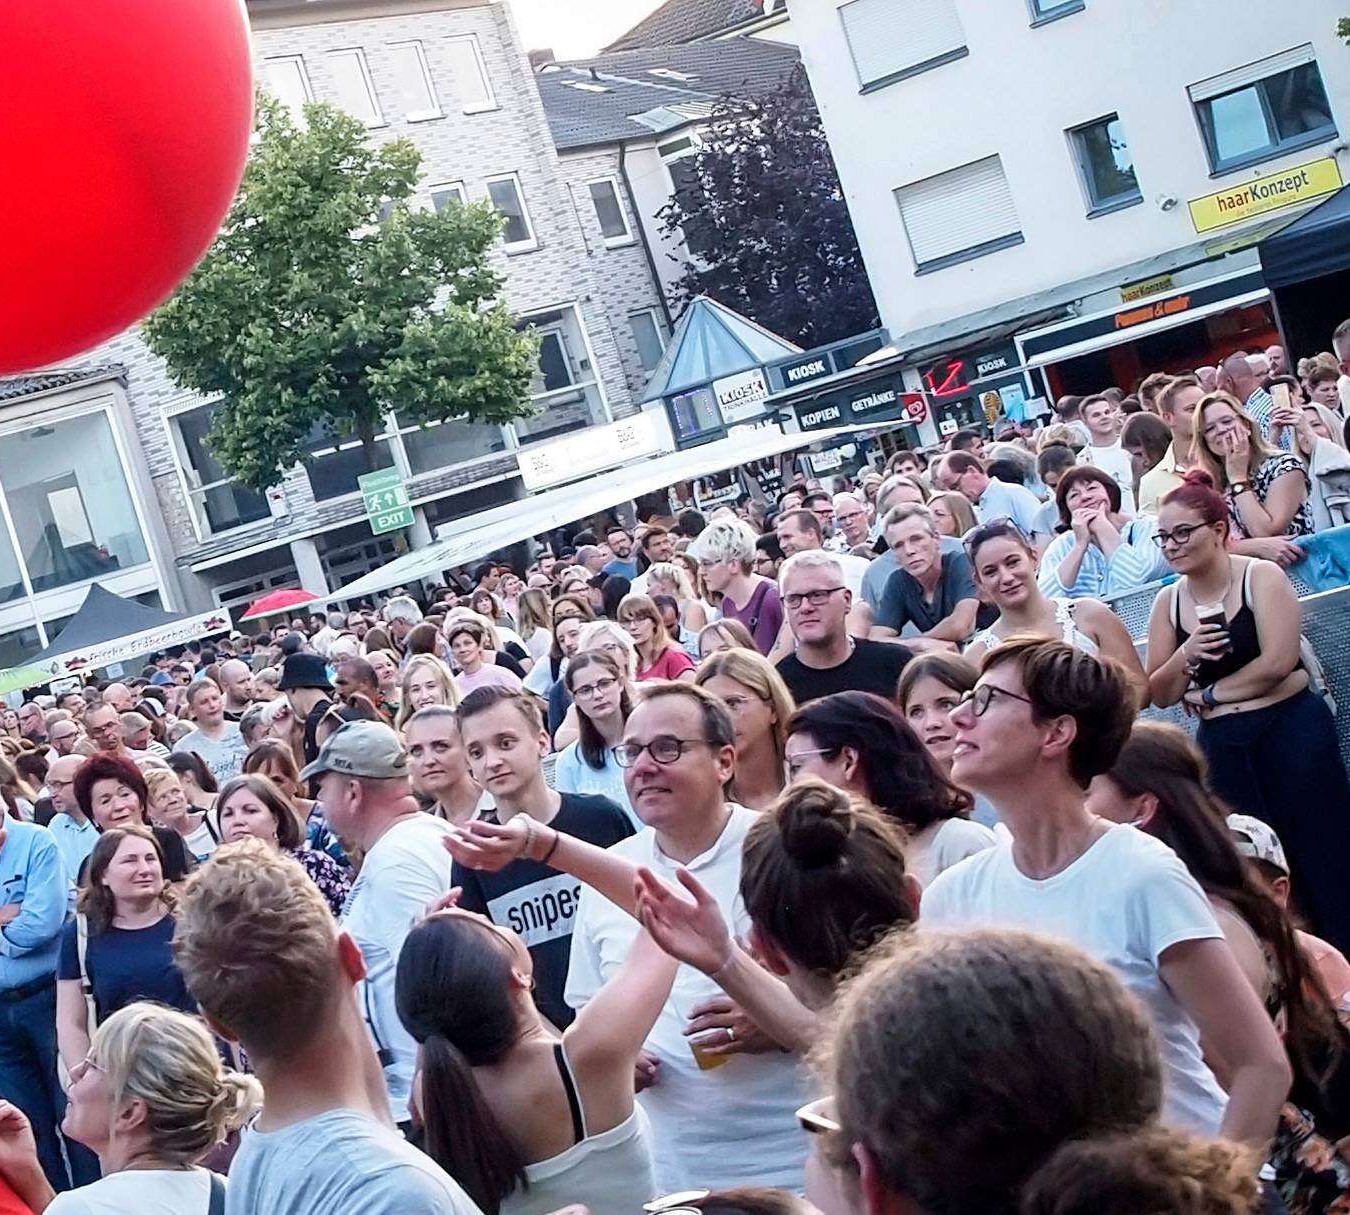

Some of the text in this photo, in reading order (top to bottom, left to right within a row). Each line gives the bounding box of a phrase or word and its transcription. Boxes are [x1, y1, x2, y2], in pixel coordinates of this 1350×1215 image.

[1216, 170, 1309, 213] haarKonzept
[788, 360, 826, 382] KIOSK
[977, 357, 1007, 375] KIOSK
[722, 380, 764, 405] KIOSK
[851, 390, 896, 412] GETRÄNKE
[801, 407, 840, 428] KOPIEN
[377, 510, 405, 528] EXIT
